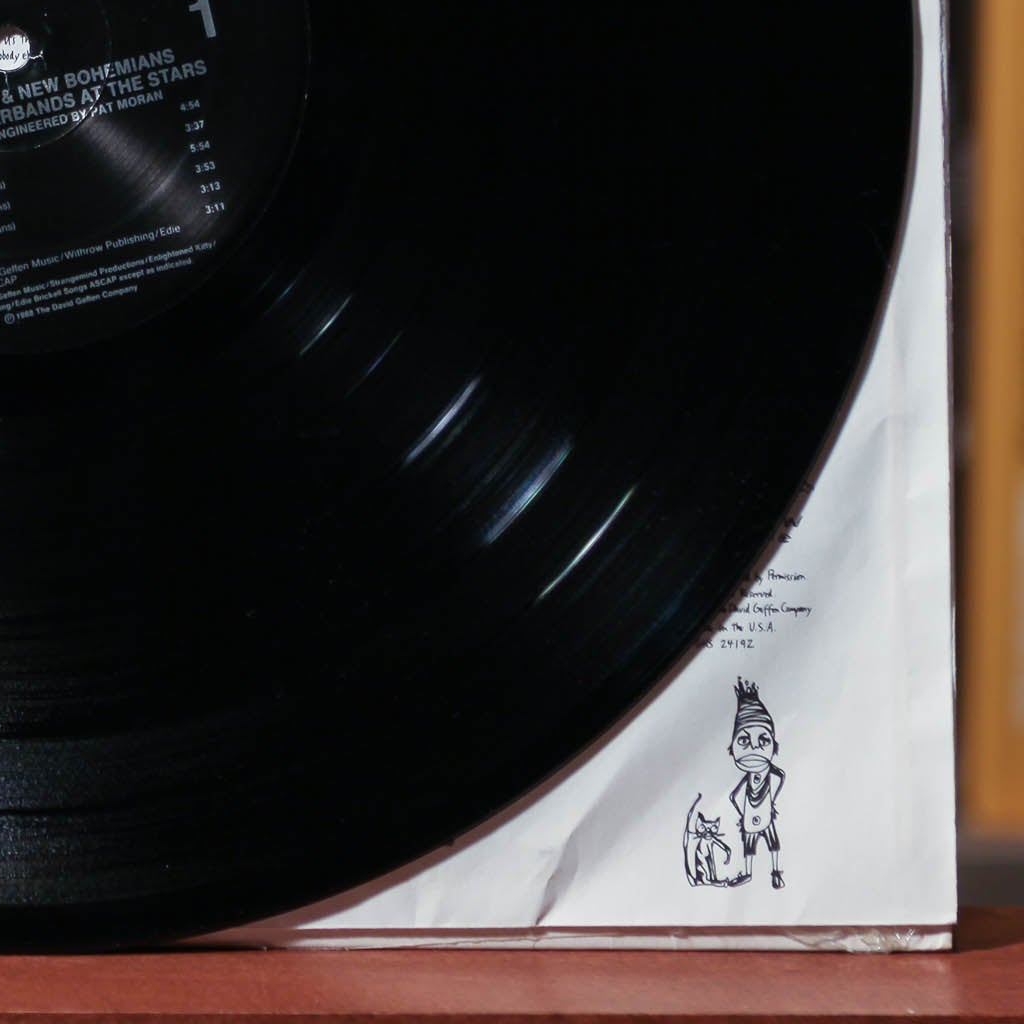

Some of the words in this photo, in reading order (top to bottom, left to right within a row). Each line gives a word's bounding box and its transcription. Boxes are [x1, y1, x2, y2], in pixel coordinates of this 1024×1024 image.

[1, 88, 15, 105] &
[17, 76, 59, 100] NEW
[63, 48, 175, 89] BOHEMIANS
[81, 84, 102, 105] AT
[106, 74, 145, 97] THE
[147, 59, 207, 88] STARS
[70, 108, 88, 122] BY
[88, 102, 113, 119] PAT
[116, 89, 164, 111] MORAN
[179, 99, 201, 112] 4:54
[185, 119, 205, 133] 3:37
[189, 140, 211, 153] 5:54
[195, 161, 216, 174] 3:53
[200, 181, 221, 194] 3:13
[204, 202, 225, 215] 3:11
[89, 275, 118, 289] ASCAP
[721, 639, 754, 648] 24192
